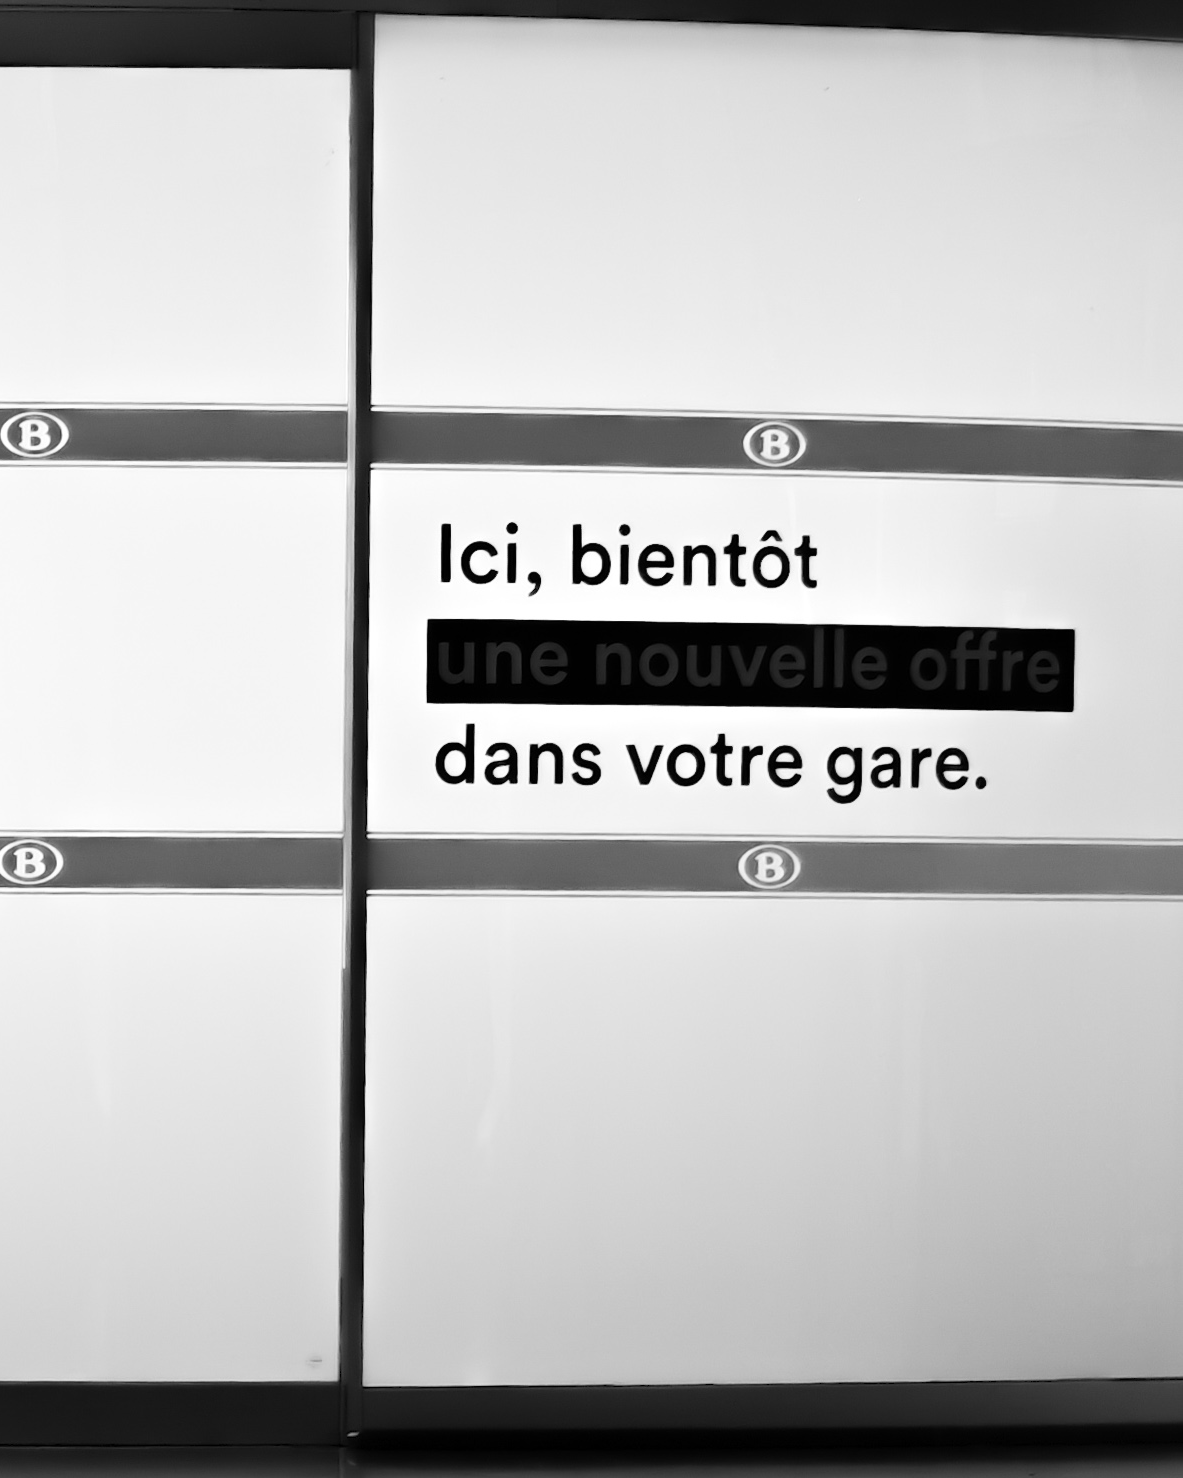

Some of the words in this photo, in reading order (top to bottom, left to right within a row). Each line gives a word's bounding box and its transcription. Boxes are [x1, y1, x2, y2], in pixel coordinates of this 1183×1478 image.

[18, 419, 51, 451] B
[760, 428, 790, 461] B
[439, 521, 542, 597] Ici,
[572, 523, 818, 589] bientôt
[438, 641, 569, 686] une
[595, 625, 888, 691] nouvelle
[910, 629, 1061, 694] offre
[435, 723, 602, 786] dans
[625, 733, 803, 788] votre
[826, 746, 987, 805] gare.
[13, 847, 46, 878] B
[754, 851, 785, 883] B
